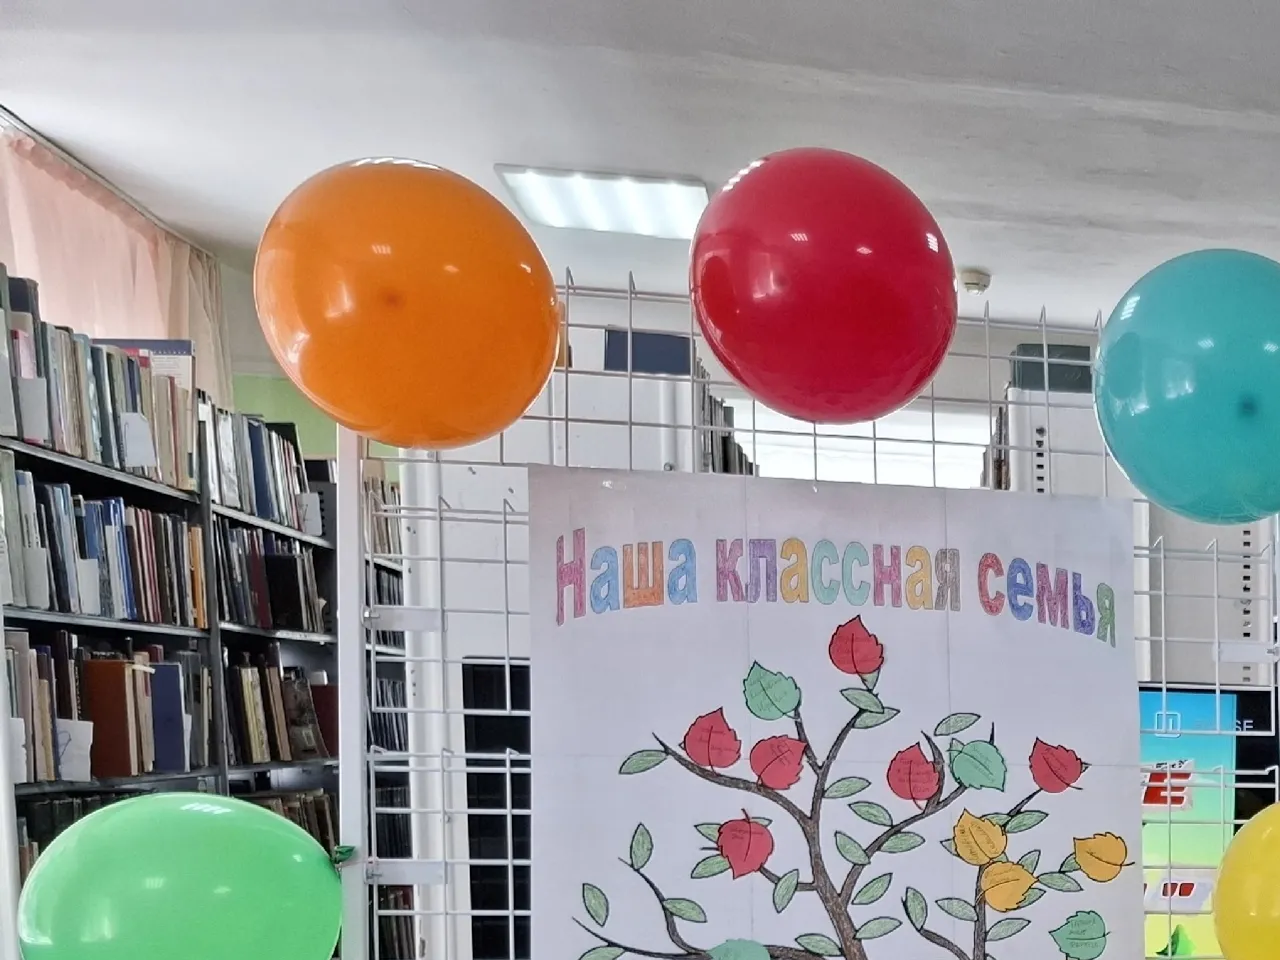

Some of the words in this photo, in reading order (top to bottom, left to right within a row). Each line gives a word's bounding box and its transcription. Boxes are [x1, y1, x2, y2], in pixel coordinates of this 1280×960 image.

[556, 527, 698, 626] Наша
[715, 537, 962, 612] классная
[978, 551, 1117, 648] семья
